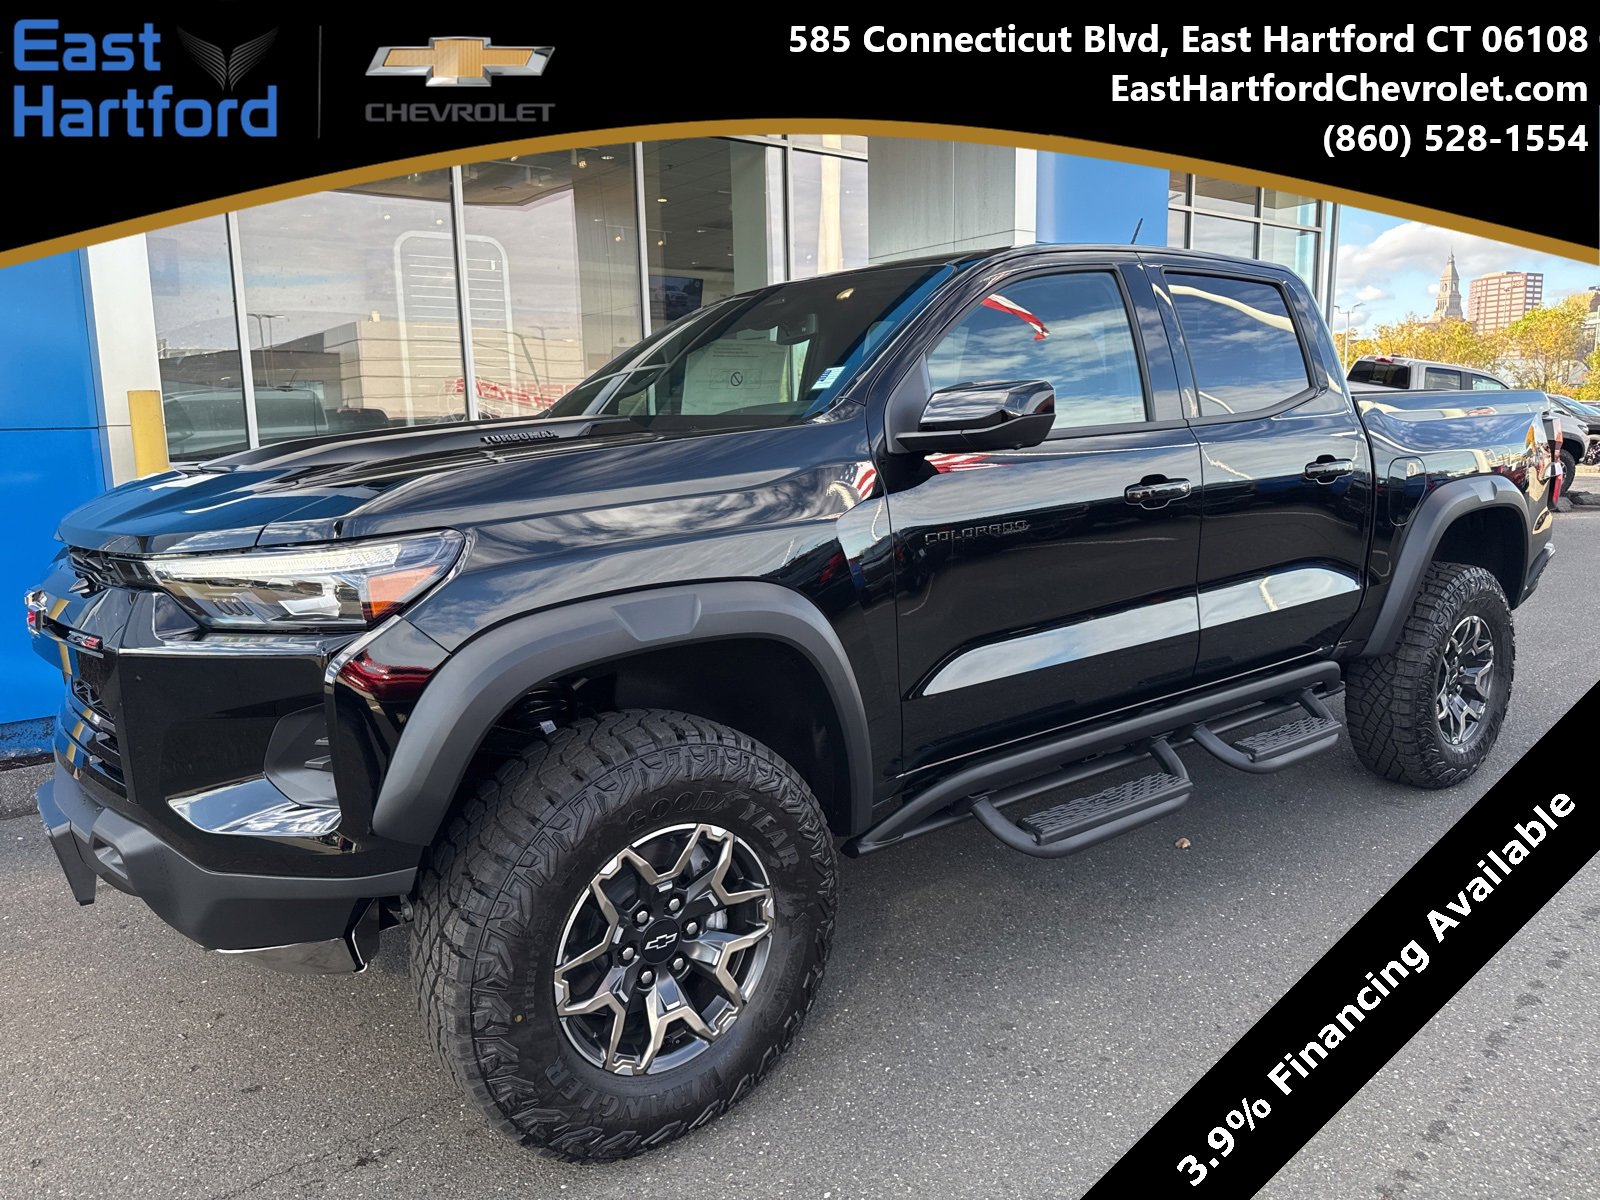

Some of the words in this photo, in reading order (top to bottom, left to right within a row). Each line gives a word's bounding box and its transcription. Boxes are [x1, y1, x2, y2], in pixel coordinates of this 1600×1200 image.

[481, 430, 559, 445] TURBOMAX
[924, 520, 1030, 544] COLORADO
[544, 1055, 724, 1121] WRANGLER
